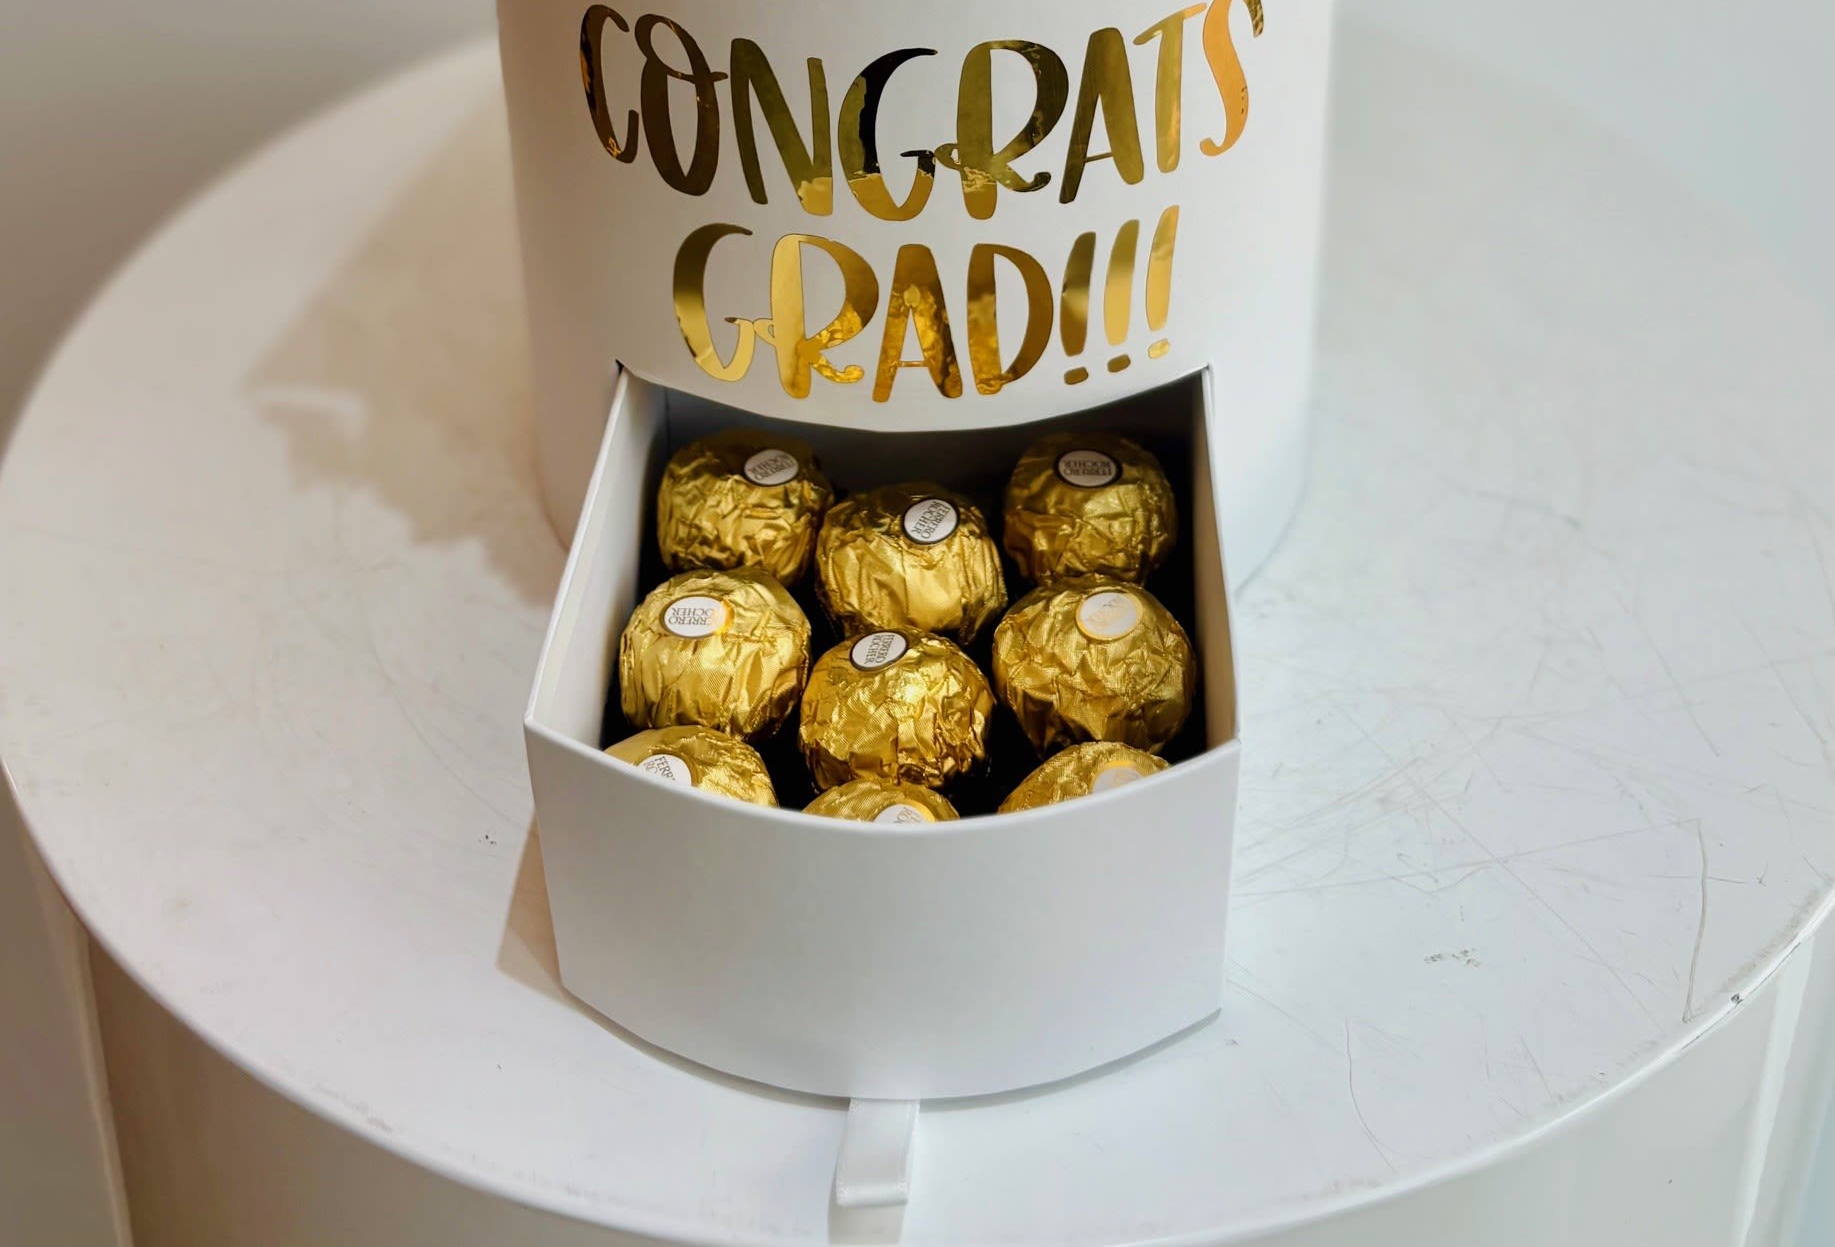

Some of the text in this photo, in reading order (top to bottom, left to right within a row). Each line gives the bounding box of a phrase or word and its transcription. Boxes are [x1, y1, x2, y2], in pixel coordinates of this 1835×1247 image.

[673, 205, 1180, 403] GRAD!!!
[911, 500, 940, 534] ROCHER
[920, 502, 951, 539] FERRERO
[671, 607, 714, 616] OCHER
[863, 634, 882, 665] ROCHER
[875, 634, 896, 664] FERRERO
